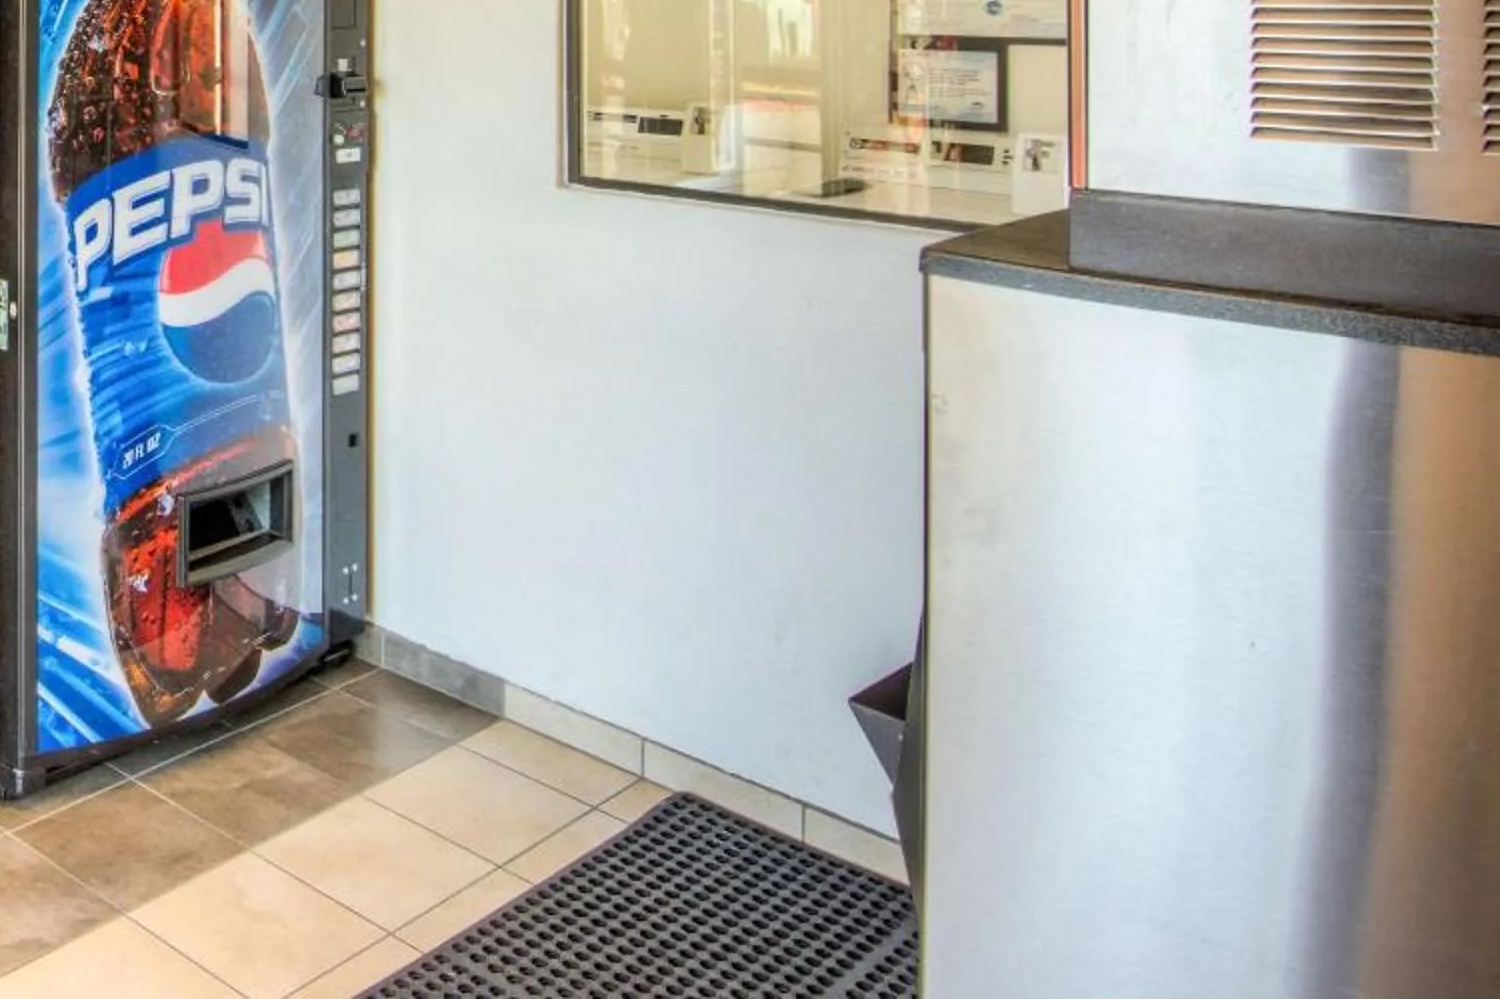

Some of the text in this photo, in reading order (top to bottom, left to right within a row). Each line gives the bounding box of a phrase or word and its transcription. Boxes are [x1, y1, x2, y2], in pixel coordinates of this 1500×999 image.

[74, 157, 269, 294] PEPSI
[135, 443, 146, 461] FL
[146, 432, 161, 453] OZ
